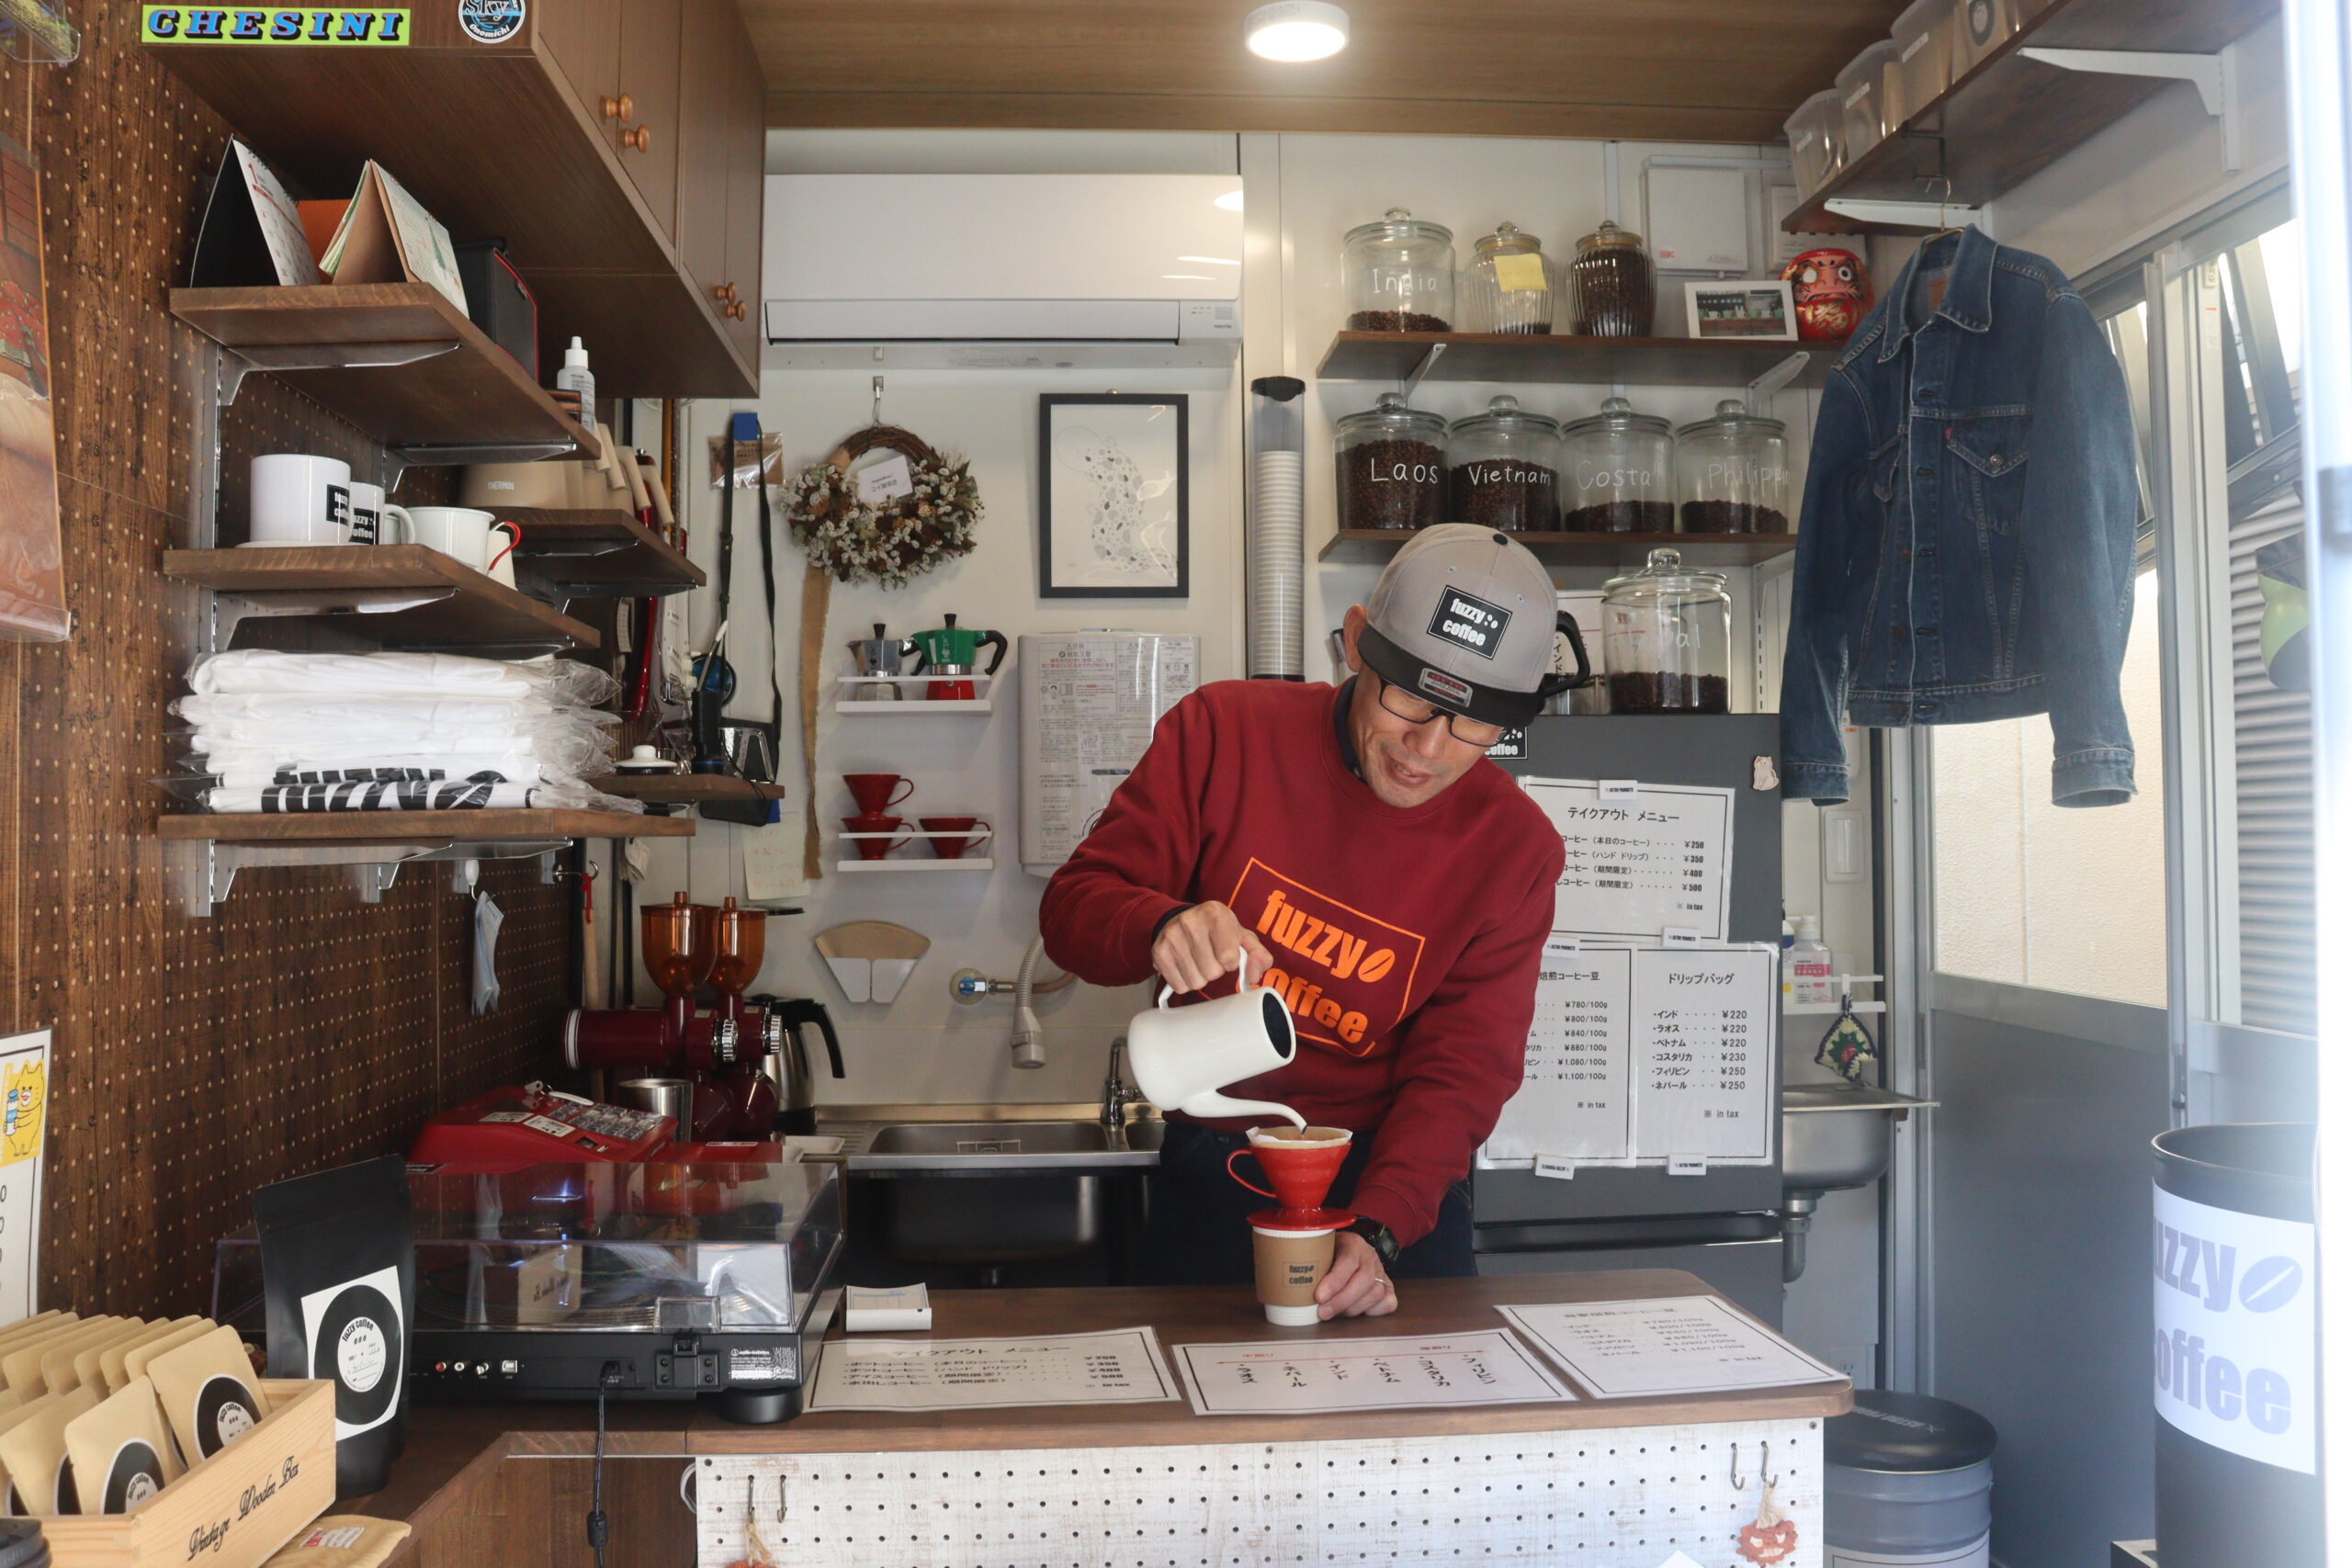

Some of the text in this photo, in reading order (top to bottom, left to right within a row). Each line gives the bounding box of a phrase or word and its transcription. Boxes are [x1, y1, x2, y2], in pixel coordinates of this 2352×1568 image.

[148, 10, 400, 40] CHESINI
[469, 24, 511, 38] Onomichi
[1373, 267, 1437, 294] India
[1371, 457, 1439, 485] Laos
[1468, 464, 1552, 488] Vietnam
[1577, 459, 1651, 491] Costa
[488, 481, 514, 491] THERMOS
[1450, 598, 1487, 625] fuzzy
[1442, 619, 1486, 646] coffee
[1567, 807, 1679, 822] テイクアウト メニュー
[1684, 840, 1704, 849] ¥250
[1683, 855, 1704, 863] ¥350
[1682, 869, 1702, 878] ¥400
[1682, 884, 1702, 892] ¥500
[1256, 889, 1368, 979] fuzzy
[1669, 973, 1736, 985] ドリップバッグ
[1236, 967, 1368, 1043] offee
[1722, 1010, 1747, 1019] ¥220
[1722, 1024, 1747, 1033] ¥220
[1721, 1039, 1747, 1047] ¥220
[1721, 1053, 1747, 1062] ¥230
[1720, 1067, 1746, 1076] ¥250
[1720, 1081, 1746, 1090] ¥250
[1716, 1110, 1724, 1118] in
[1289, 1276, 1313, 1284] coffee
[342, 1318, 374, 1342] fuzzy coffee
[187, 1454, 300, 1562] Vintage Wooden Box
